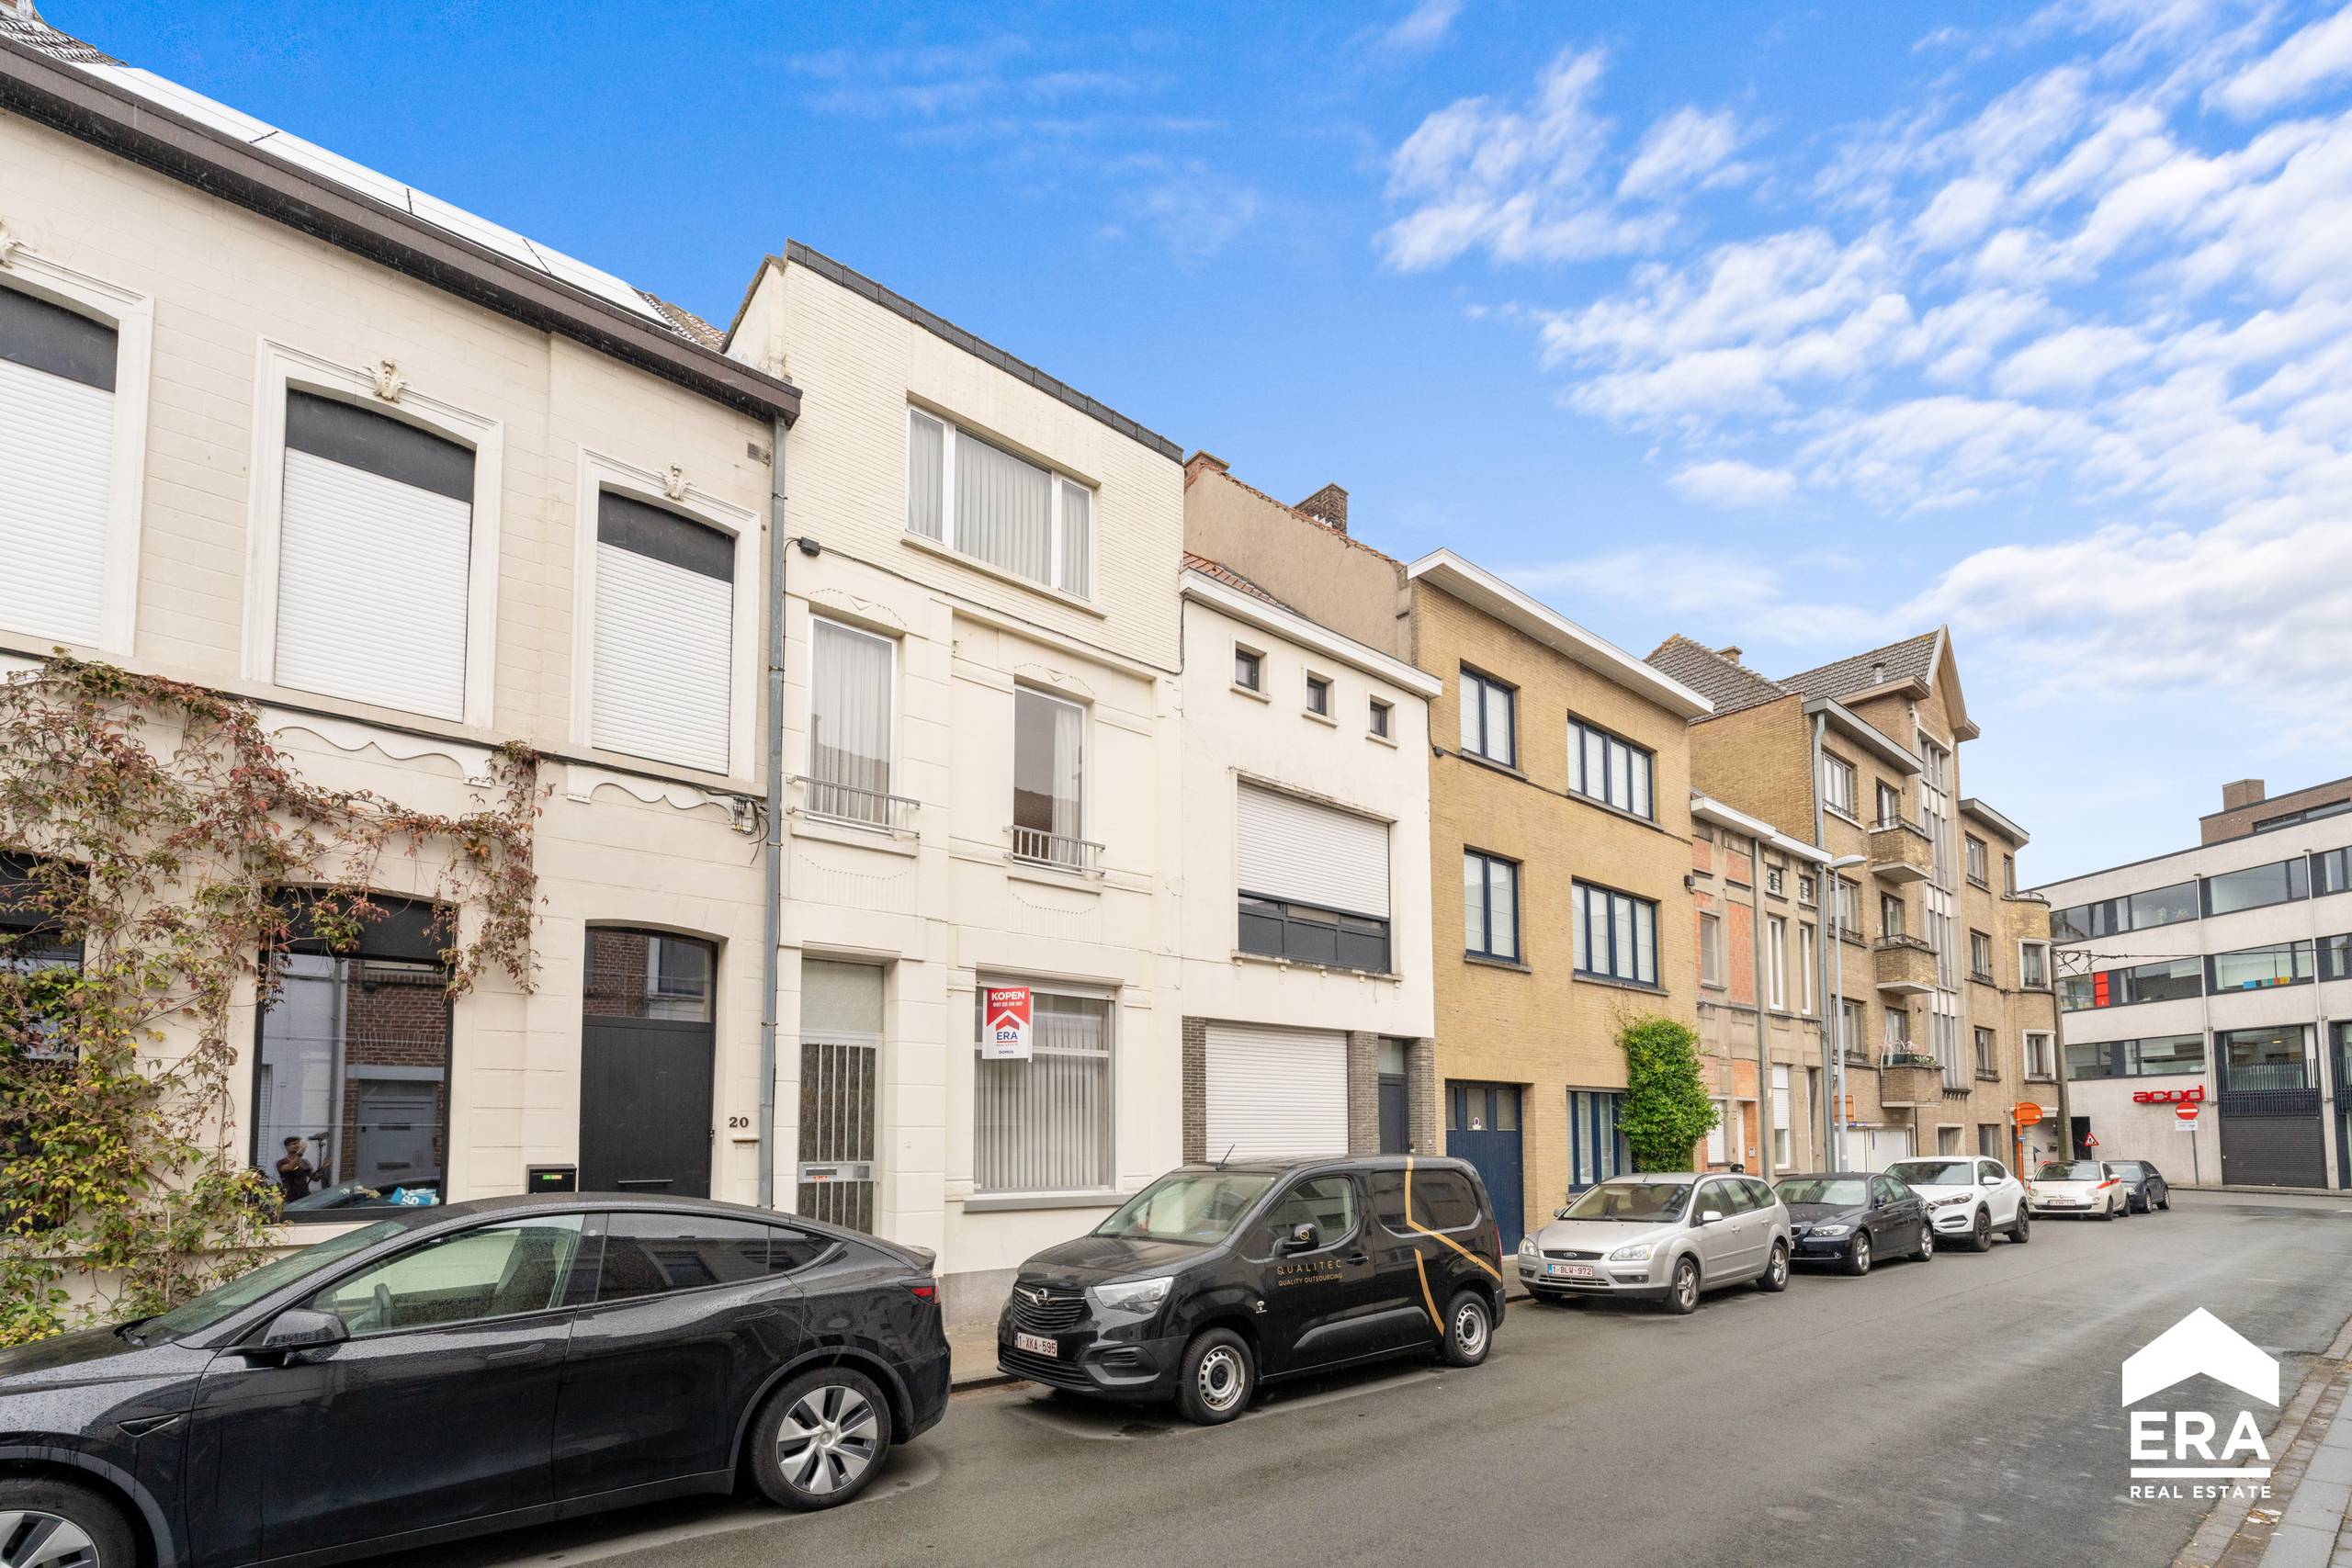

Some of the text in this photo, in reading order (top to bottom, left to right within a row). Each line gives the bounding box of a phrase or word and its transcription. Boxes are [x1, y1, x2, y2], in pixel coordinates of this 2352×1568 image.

[991, 991, 1025, 1001] KOPEN
[996, 1031, 1018, 1041] ERA
[2132, 1085, 2204, 1103] acod
[729, 1116, 749, 1128] 20
[1276, 1259, 1343, 1276] QUALITEC
[1553, 1266, 1592, 1276] 1-BLW-972
[1278, 1277, 1303, 1286] QUALITY
[1019, 1335, 1057, 1354] 1-XKA-595
